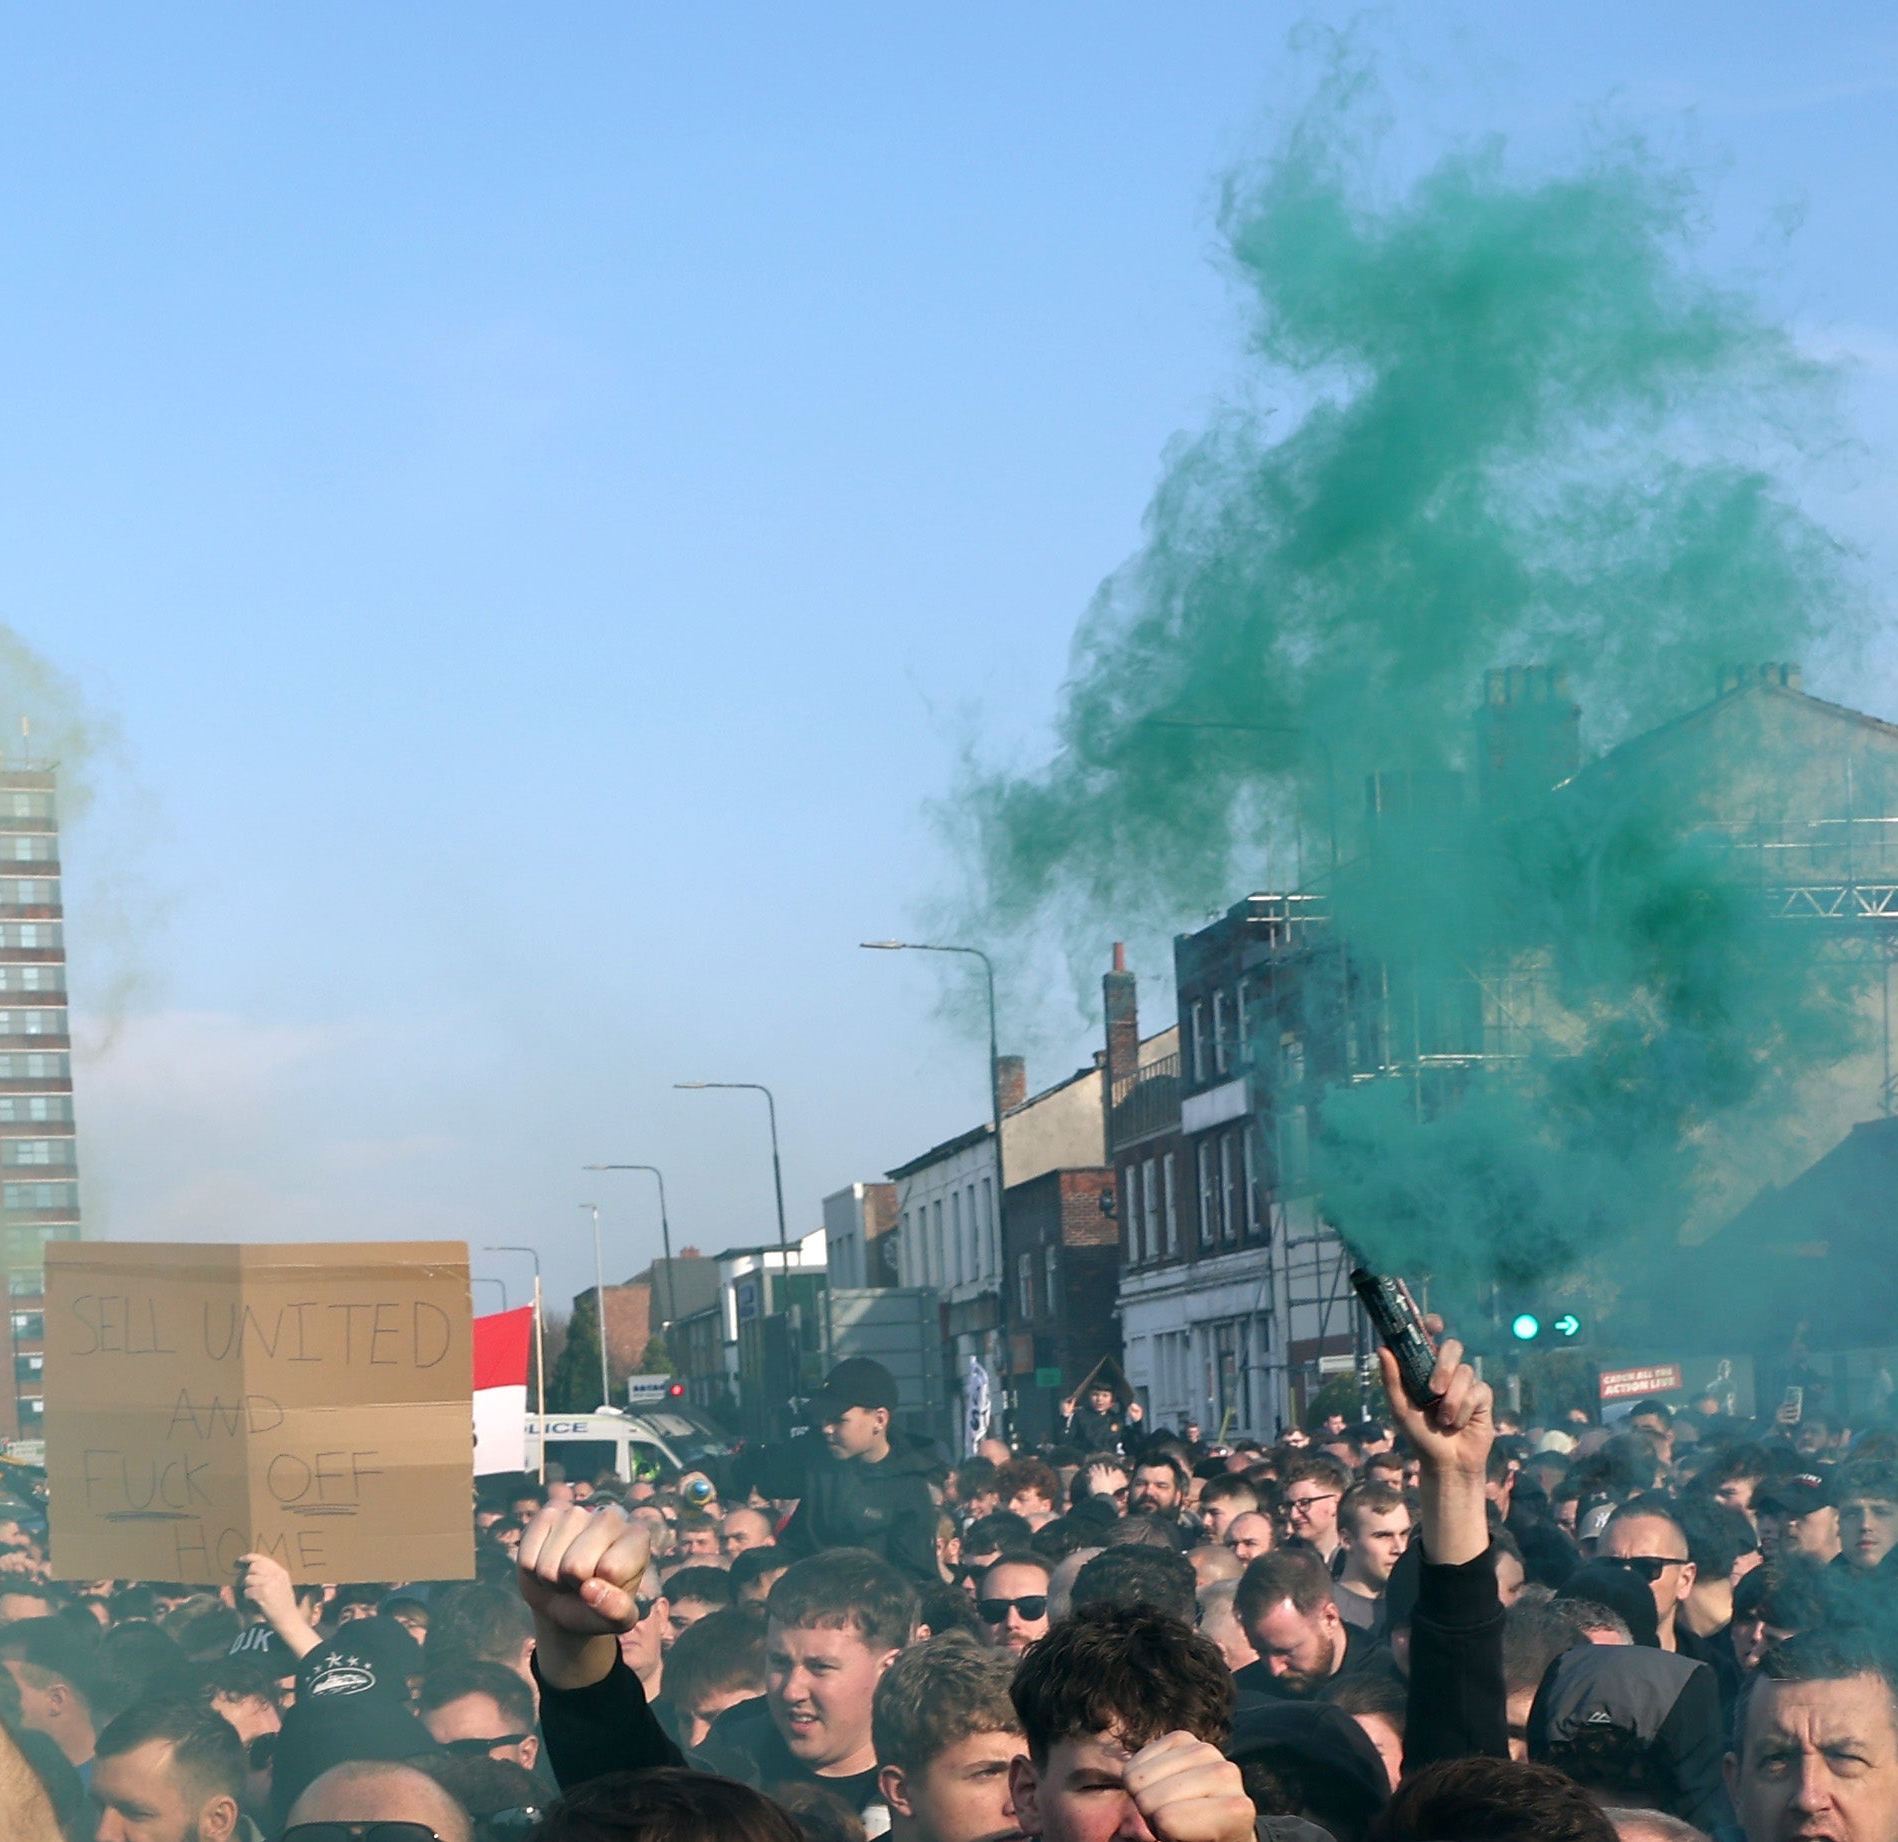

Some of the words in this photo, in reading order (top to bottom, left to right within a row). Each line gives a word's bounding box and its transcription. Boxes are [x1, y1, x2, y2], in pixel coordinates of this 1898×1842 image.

[70, 1294, 176, 1355] SELL
[204, 1301, 451, 1368] UNITED
[167, 1388, 285, 1440] AND
[1604, 1380, 1648, 1395] ACTION
[524, 1421, 588, 1435] LICE
[83, 1449, 212, 1509] FUCK
[267, 1451, 384, 1502] OFF
[175, 1524, 328, 1580] HOME
